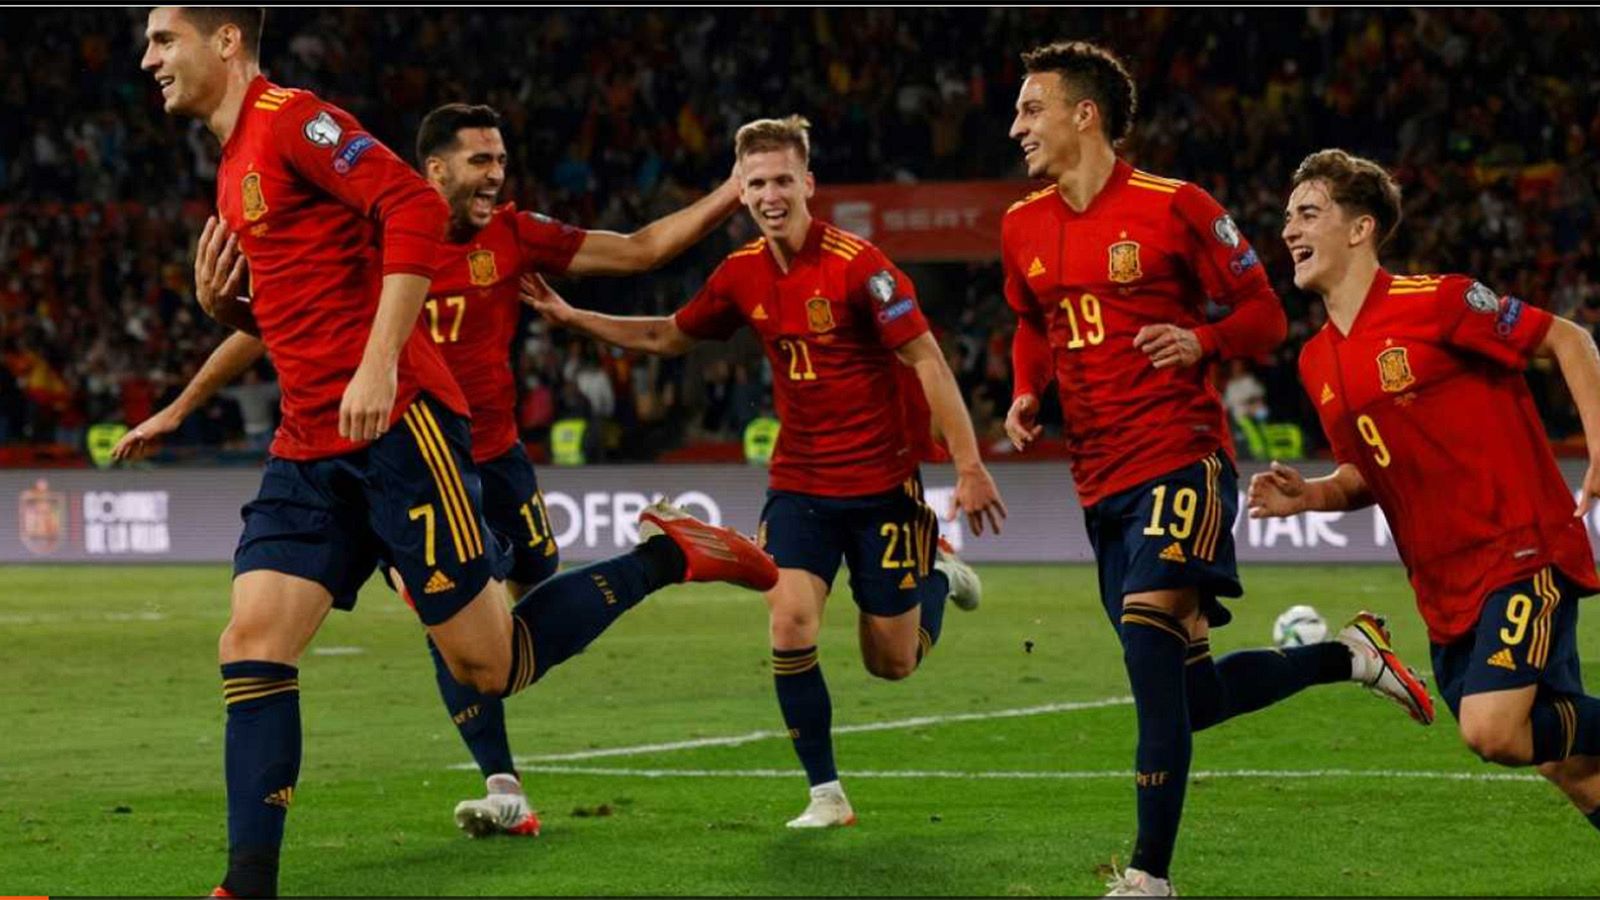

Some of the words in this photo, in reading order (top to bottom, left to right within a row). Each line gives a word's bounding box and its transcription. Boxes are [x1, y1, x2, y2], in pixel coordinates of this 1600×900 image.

[425, 295, 466, 343] 17
[1060, 293, 1105, 349] 19
[779, 339, 817, 380] 21
[1357, 414, 1391, 468] 9
[408, 503, 436, 567] 7
[1142, 484, 1198, 539] 19
[880, 522, 916, 569] 21
[1500, 593, 1533, 645] 9
